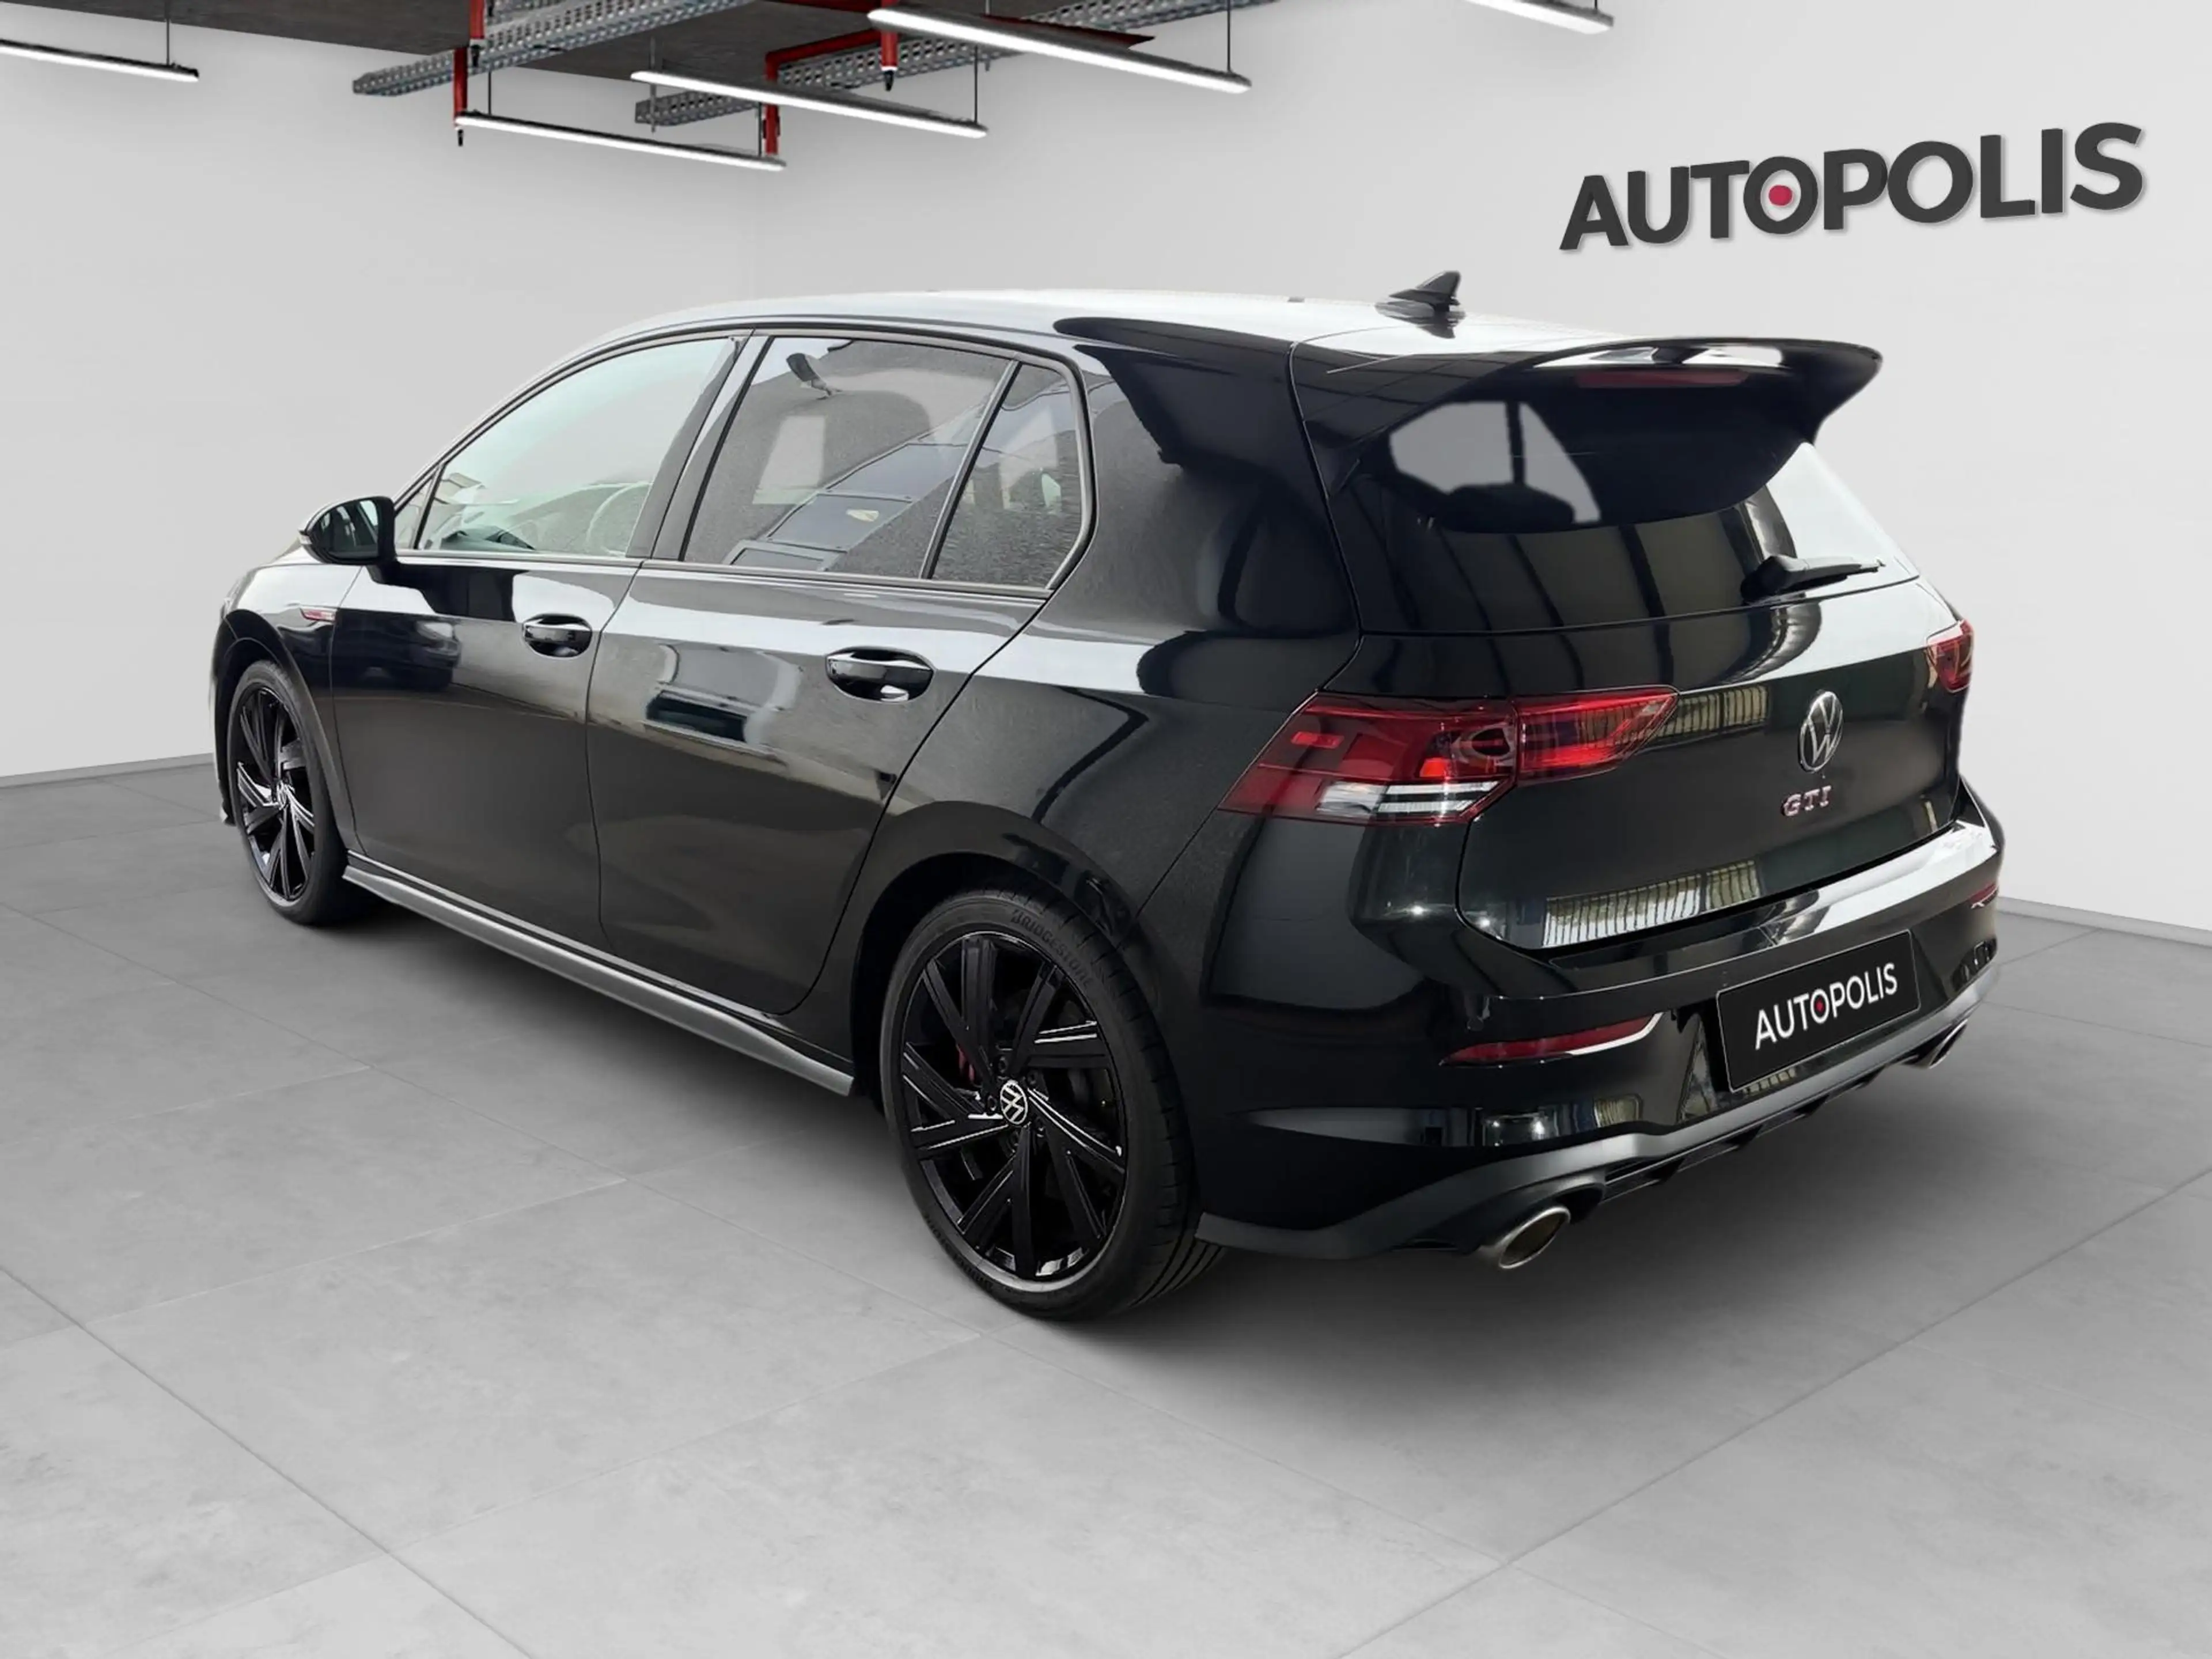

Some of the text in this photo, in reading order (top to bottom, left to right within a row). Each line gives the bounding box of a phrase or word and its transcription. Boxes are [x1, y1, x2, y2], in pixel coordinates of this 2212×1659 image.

[1559, 122, 2144, 251] AUTOPOLIS
[1782, 784, 1832, 817] GTI
[1755, 962, 1898, 1051] AUTOPOLIS
